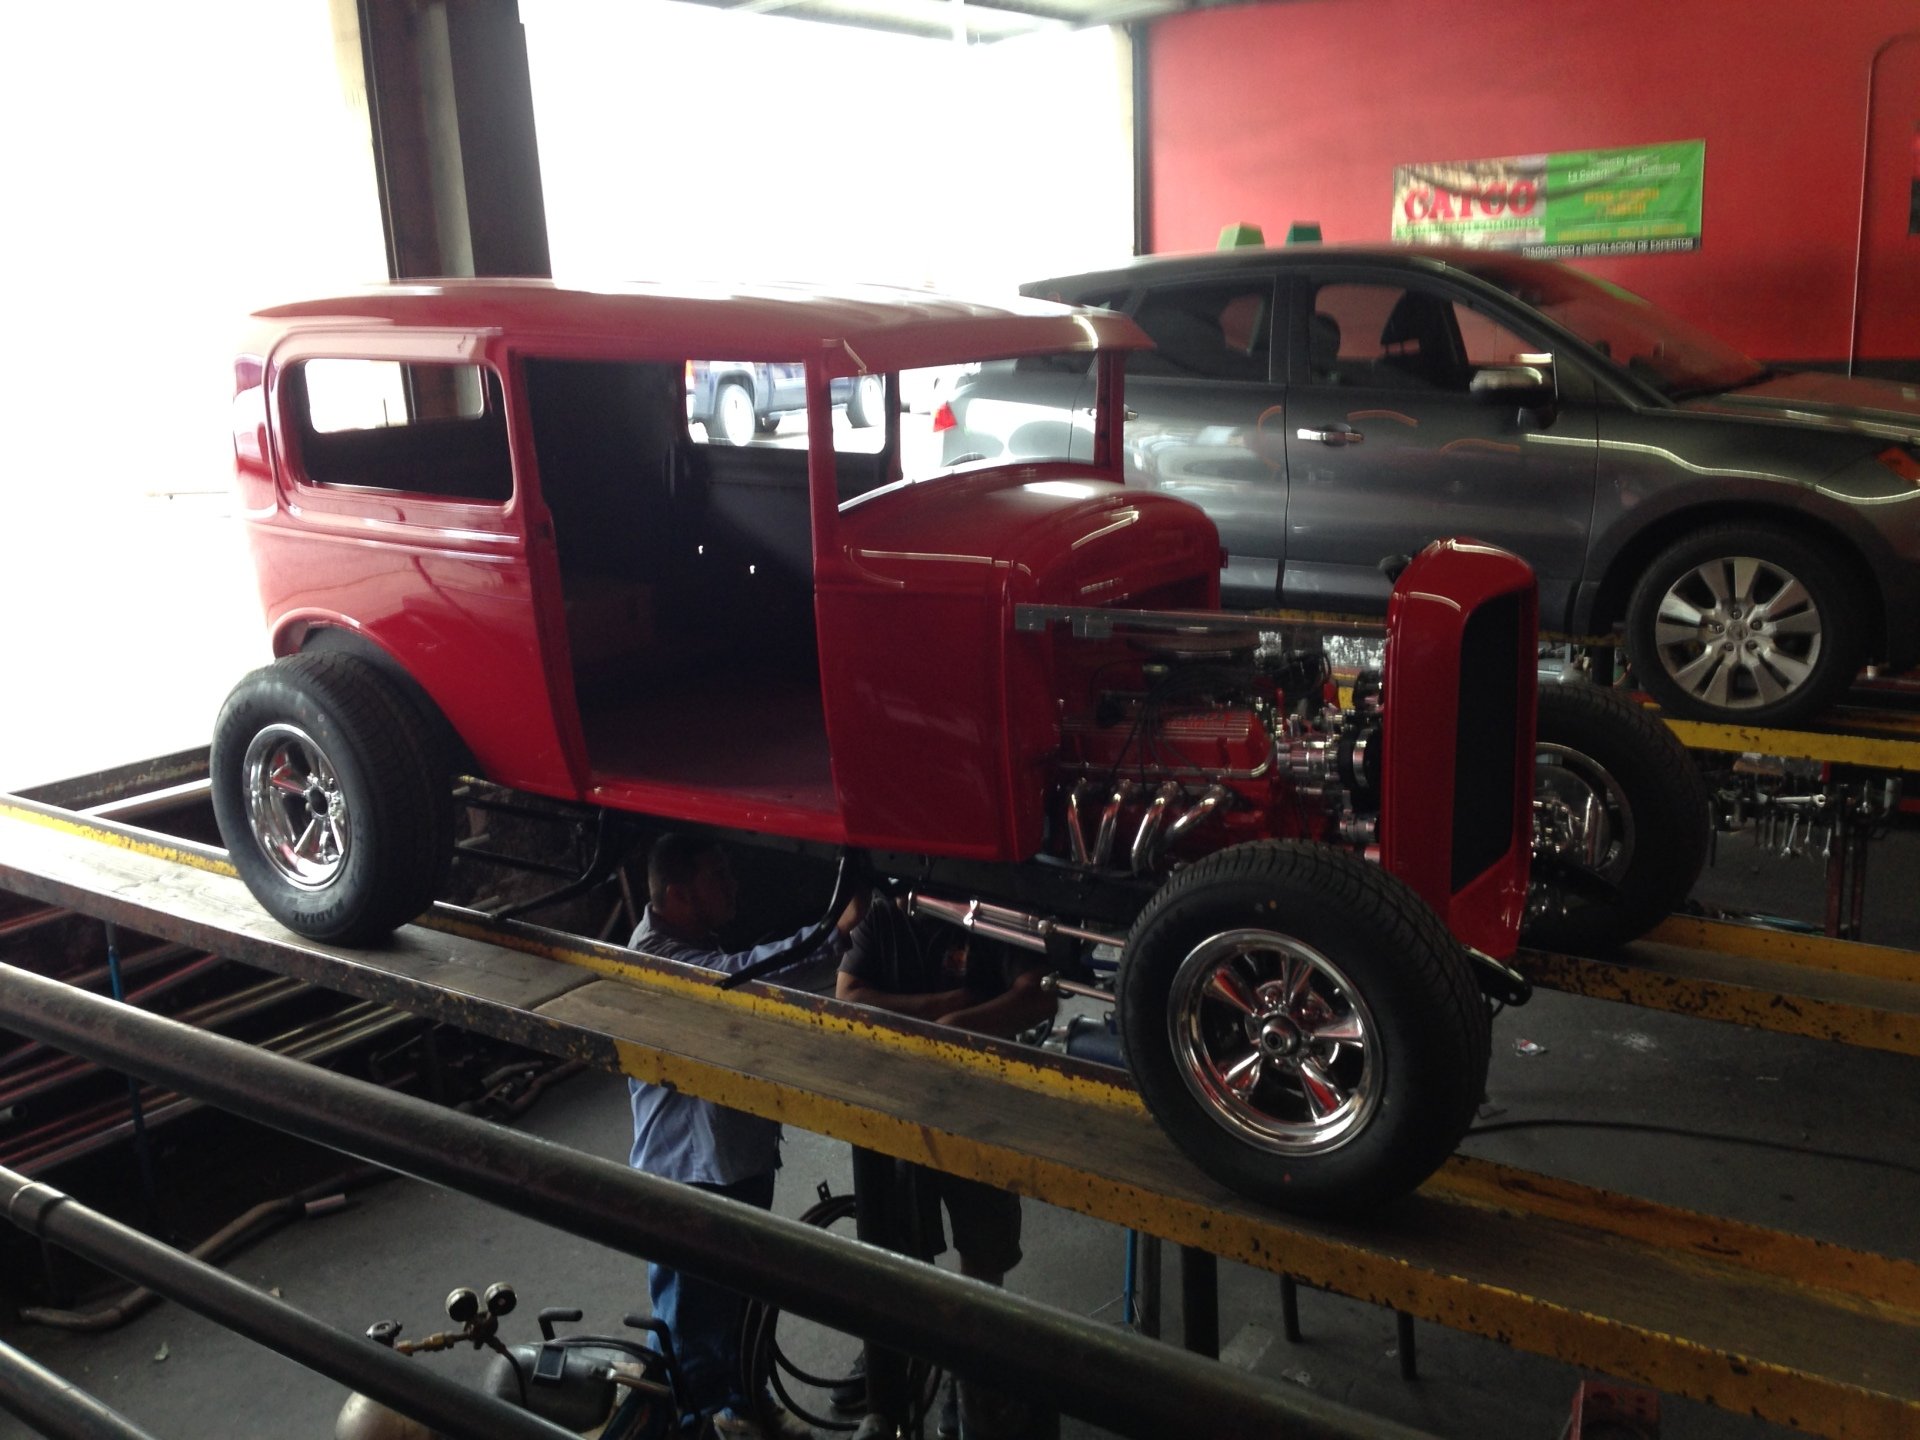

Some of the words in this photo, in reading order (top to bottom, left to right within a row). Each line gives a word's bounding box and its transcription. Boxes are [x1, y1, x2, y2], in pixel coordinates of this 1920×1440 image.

[1403, 178, 1538, 221] CATCO
[1638, 240, 1649, 251] DE
[1651, 237, 1694, 250] EXPERTOS
